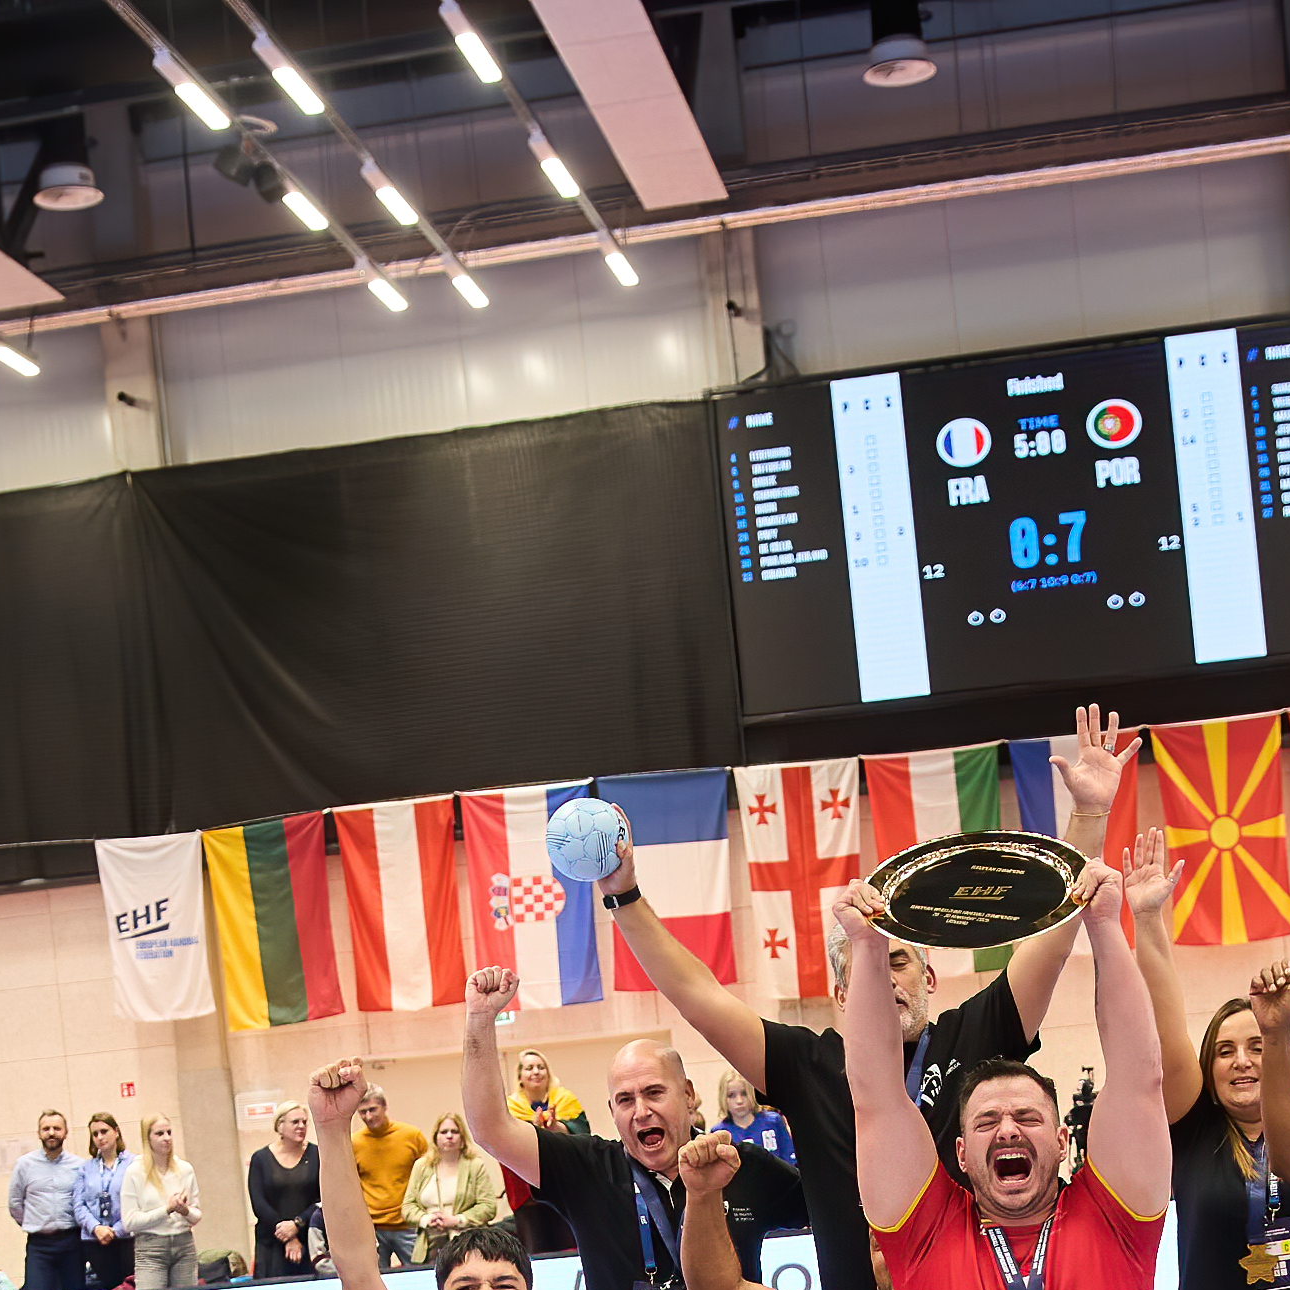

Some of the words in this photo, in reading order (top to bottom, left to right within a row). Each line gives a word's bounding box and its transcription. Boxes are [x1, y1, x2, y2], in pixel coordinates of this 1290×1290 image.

[1017, 414, 1060, 430] TIME
[1013, 428, 1067, 459] 5:00
[1094, 456, 1141, 488] POR
[947, 474, 991, 506] FRA
[1009, 510, 1087, 569] 0:7
[1158, 534, 1182, 551] 12
[922, 563, 946, 580] 12
[954, 885, 1013, 897] EHF
[115, 897, 170, 934] EHF
